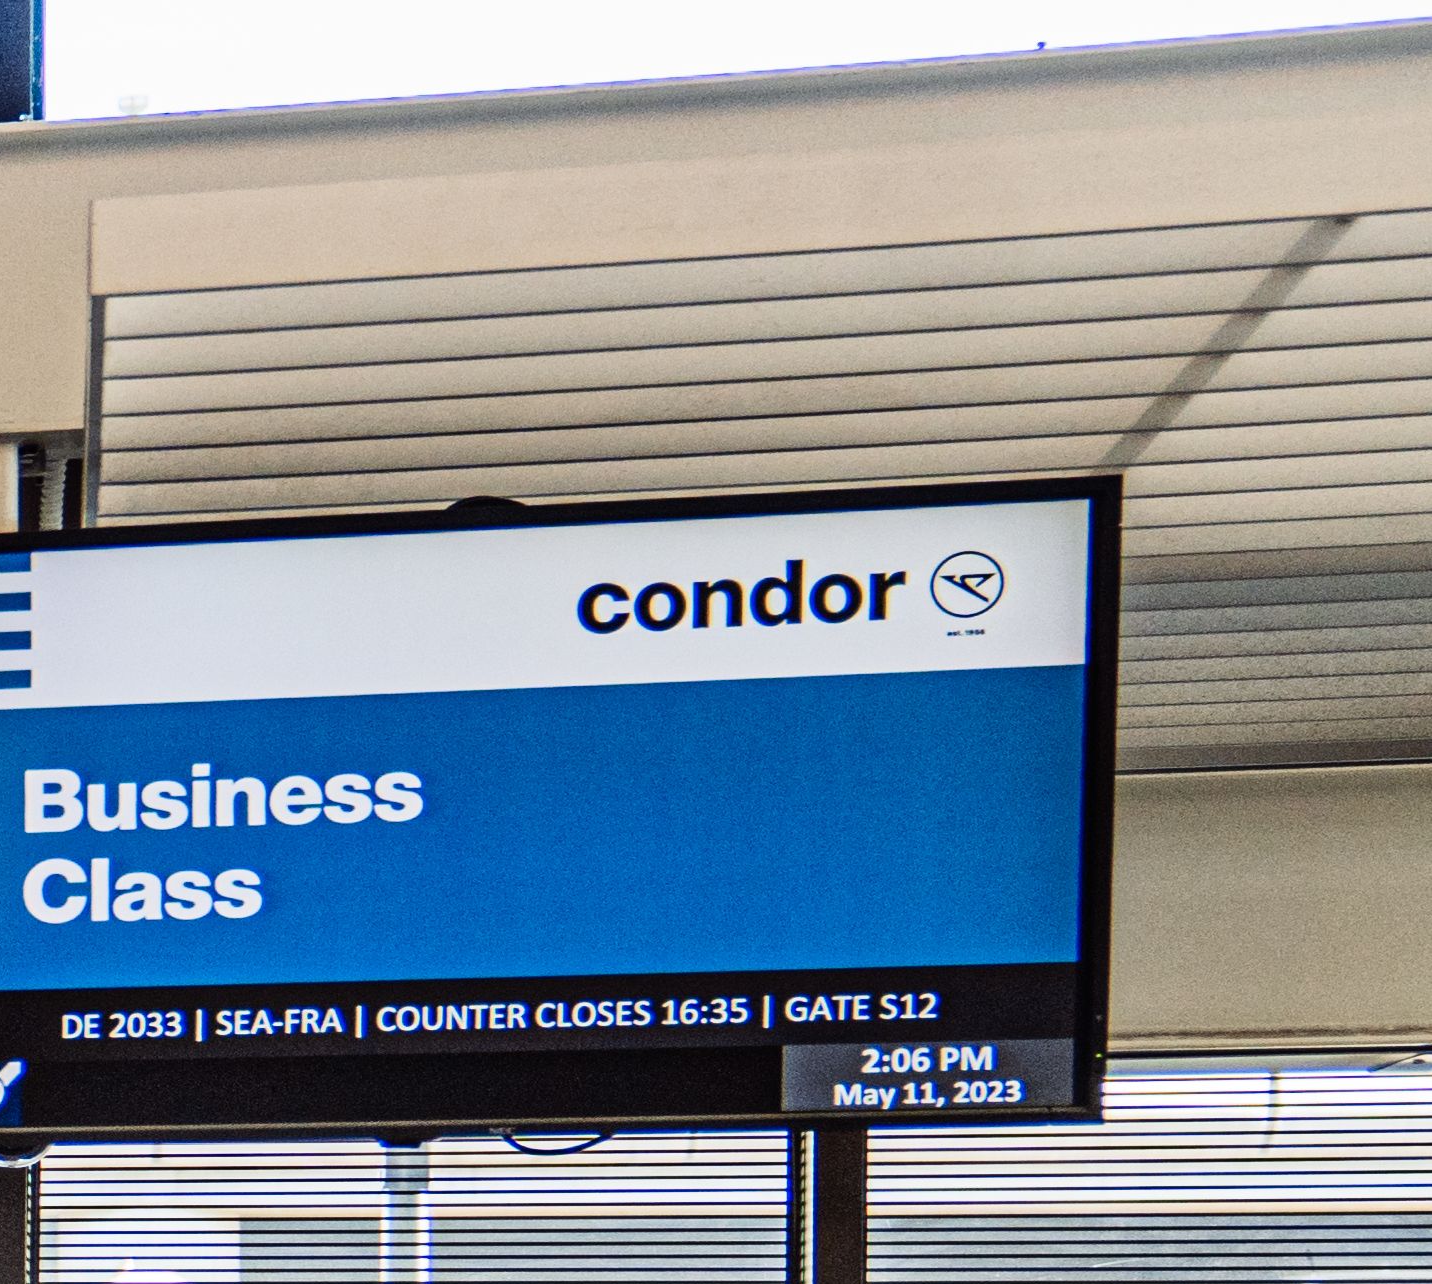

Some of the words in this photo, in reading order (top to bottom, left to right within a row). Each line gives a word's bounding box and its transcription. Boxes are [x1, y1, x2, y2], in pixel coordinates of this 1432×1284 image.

[577, 560, 906, 634] condor
[25, 763, 423, 833] Business
[23, 858, 262, 923] Class
[61, 1013, 101, 1040] DE
[108, 1011, 183, 1039] 2033
[215, 1007, 344, 1036] SEA-FRA
[375, 1003, 527, 1033] COUNTER
[534, 999, 652, 1030] CLOSES
[662, 997, 749, 1026] 16:35
[784, 994, 871, 1023] GATE
[878, 992, 938, 1020] S12
[860, 1046, 931, 1074] 2:06
[939, 1045, 993, 1072] PM
[833, 1083, 896, 1112] May
[902, 1081, 946, 1108] 11,
[952, 1079, 1022, 1104] 2023
